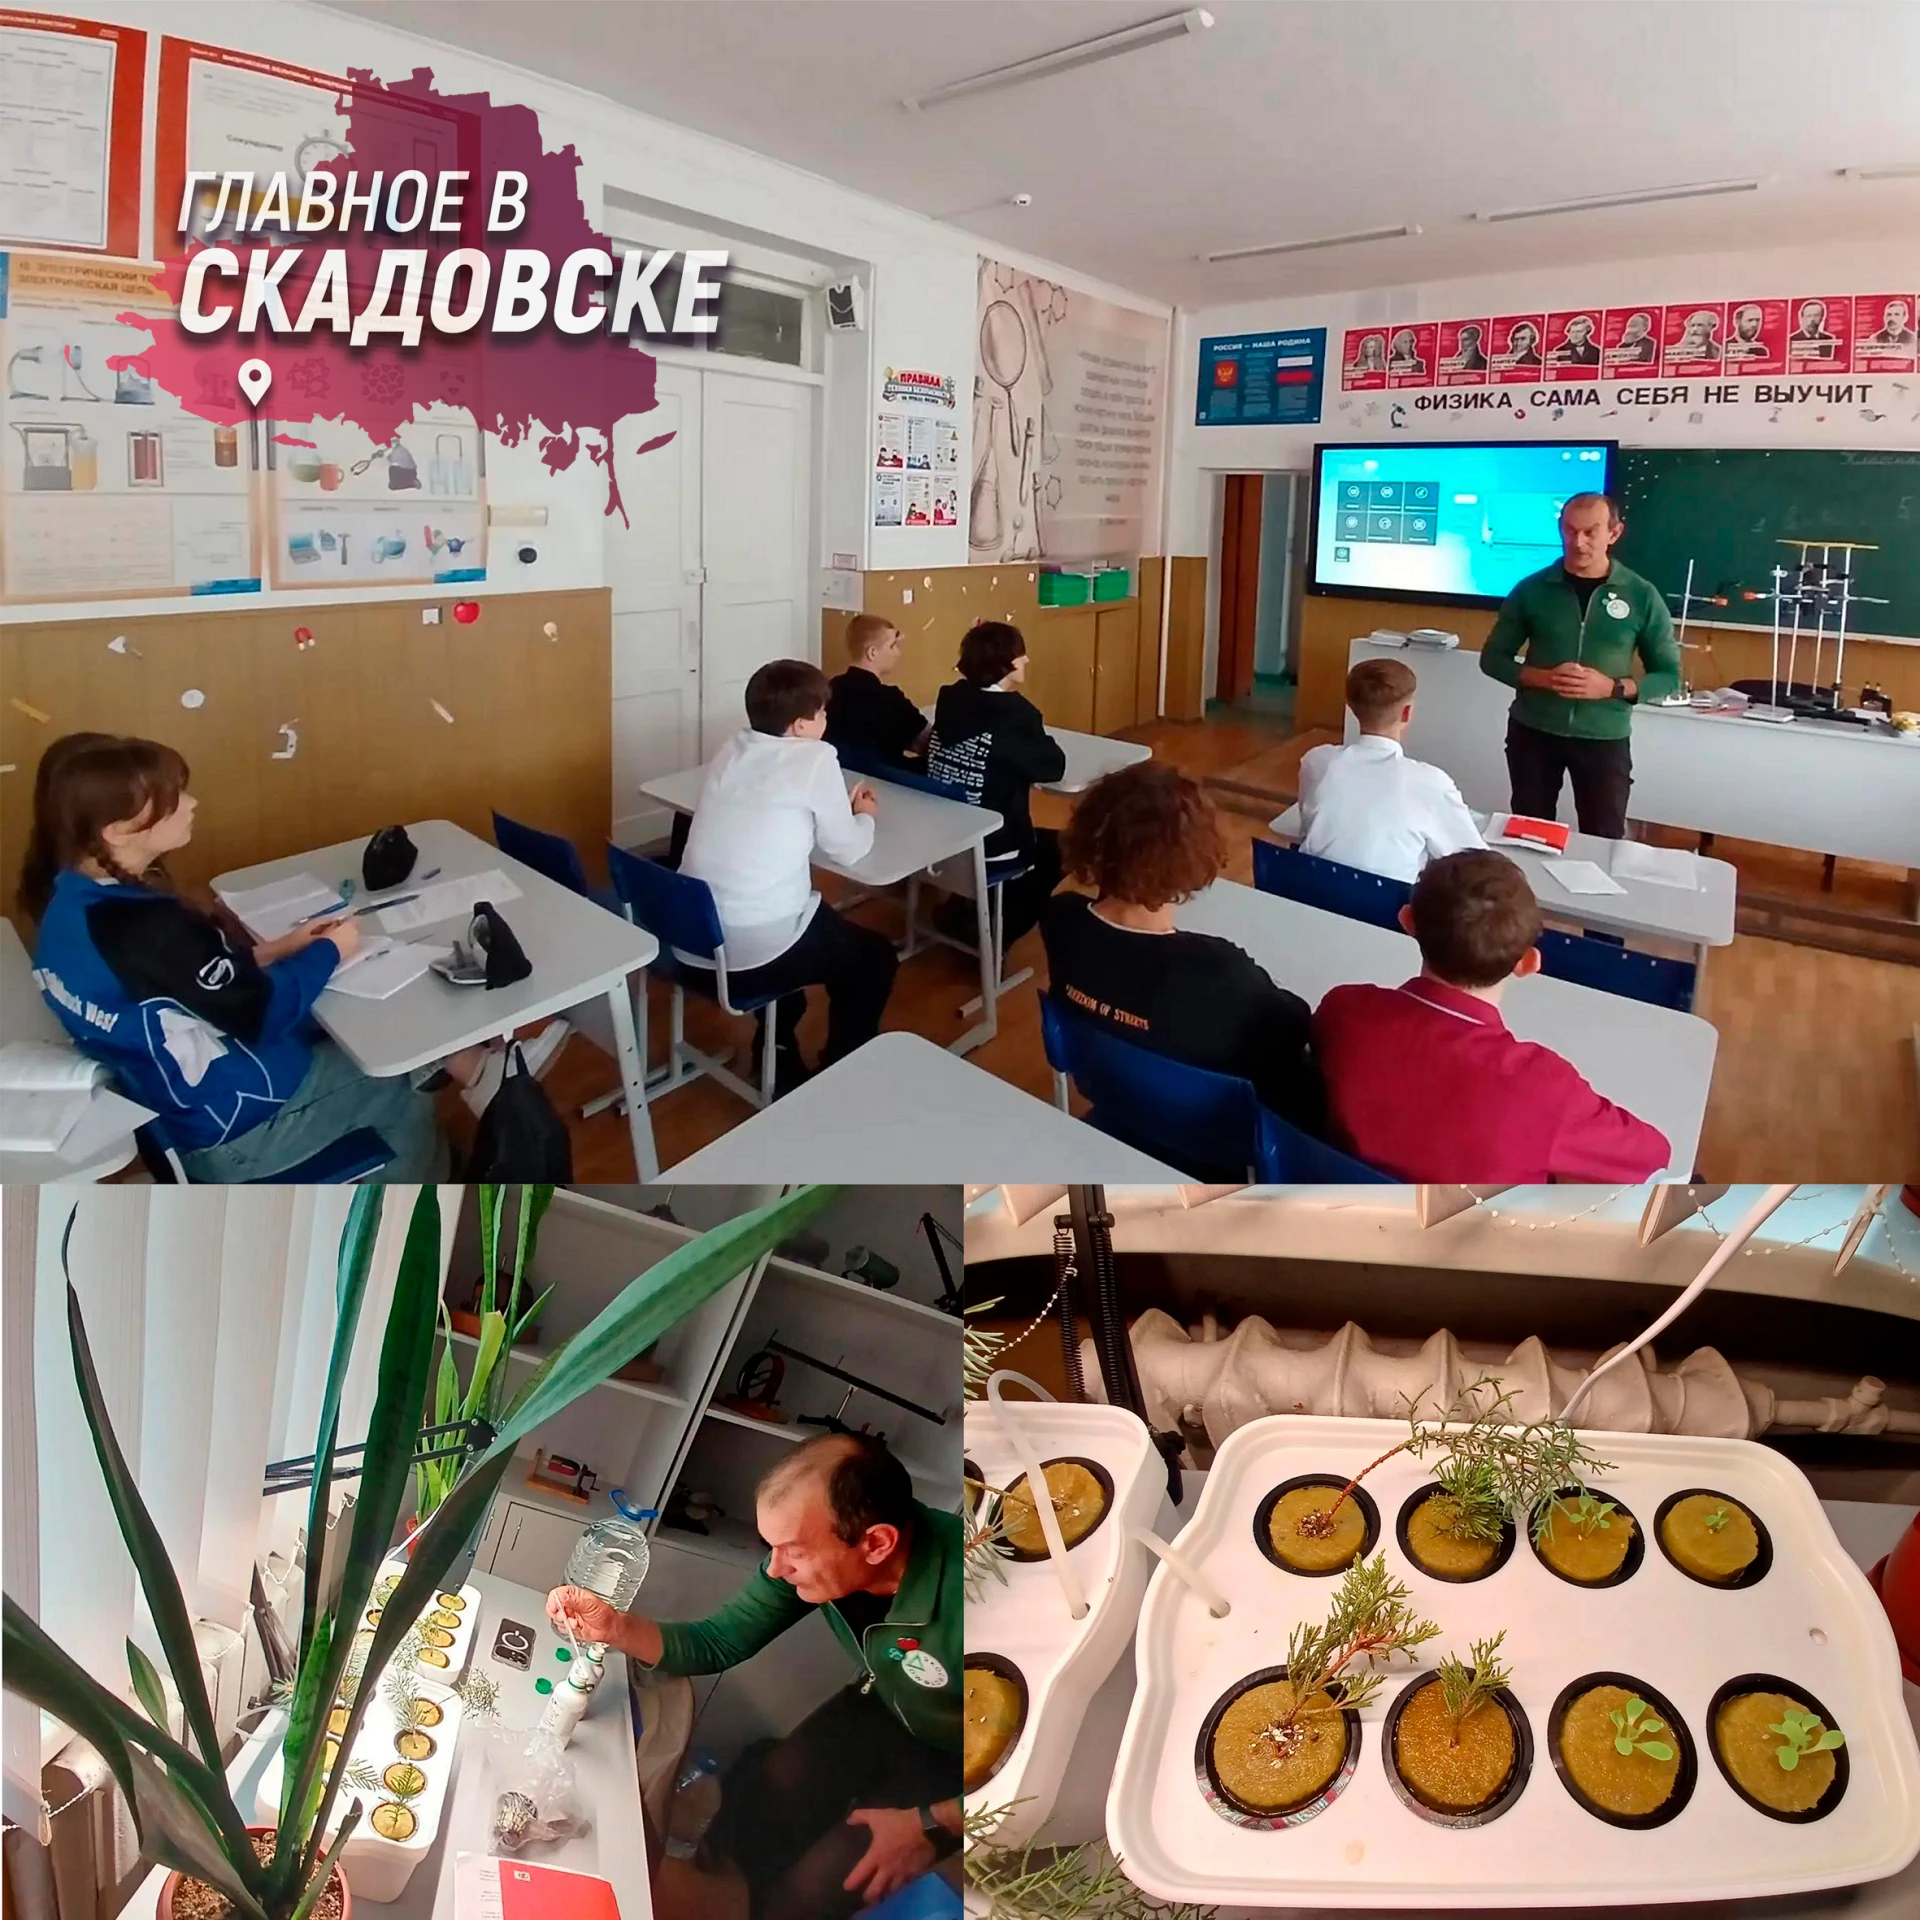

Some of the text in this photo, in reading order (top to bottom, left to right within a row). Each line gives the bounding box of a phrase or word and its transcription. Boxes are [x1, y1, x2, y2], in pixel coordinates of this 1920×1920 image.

[1213, 343, 1243, 352] РОССИЯ
[1252, 340, 1276, 349] НАША
[1277, 337, 1311, 347] РОДИНА
[899, 373, 941, 387] ПРАВИЛА
[1414, 383, 1873, 411] ФИЗИКА САМА СЕБЯ НЕ ВЫУЧИТ
